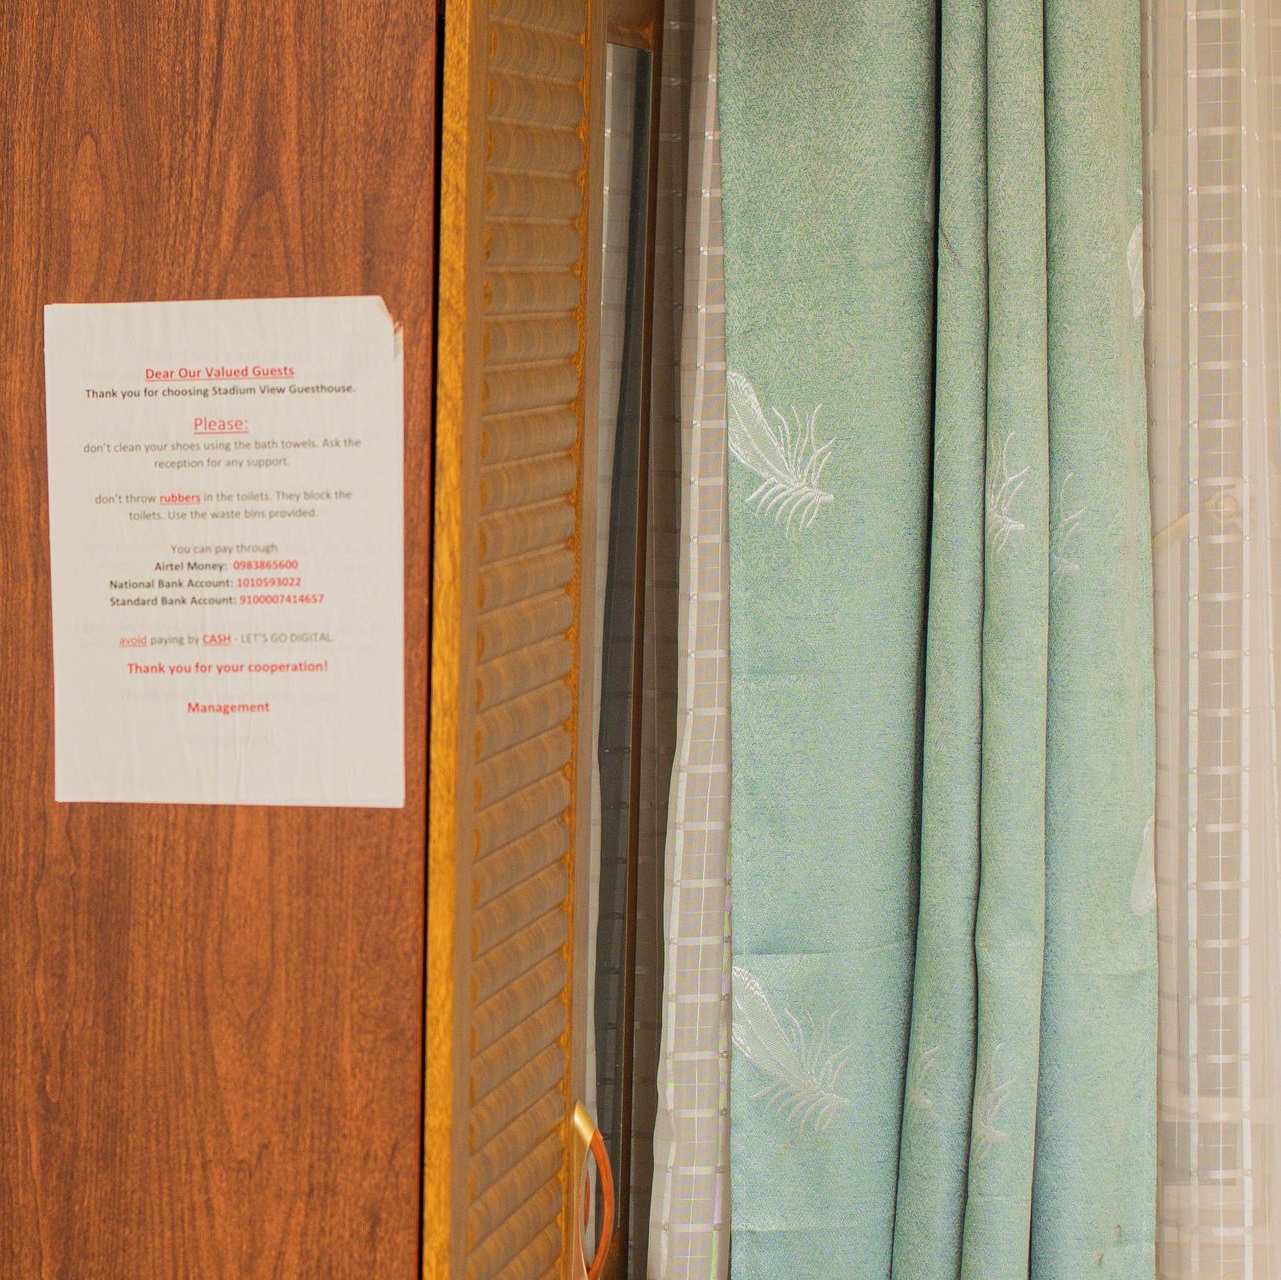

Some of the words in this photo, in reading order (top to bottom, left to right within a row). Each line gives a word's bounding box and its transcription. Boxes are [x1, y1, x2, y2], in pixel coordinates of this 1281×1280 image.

[145, 368, 174, 380] Dear
[178, 368, 201, 378] Our
[206, 367, 248, 378] Valued
[253, 366, 294, 377] Guests
[86, 389, 118, 399] Thank
[121, 390, 140, 400] you
[143, 388, 158, 397] for
[162, 387, 208, 398] choosing
[212, 386, 255, 396] Stadium
[260, 385, 285, 394] View
[289, 384, 356, 394] Guesthouse.
[193, 417, 249, 431] Please:
[114, 442, 141, 452] clean
[144, 443, 167, 453] your
[170, 441, 200, 451] shoes
[203, 441, 230, 452] using
[234, 440, 251, 449] the
[255, 440, 278, 449] bath
[281, 439, 318, 448] towels.
[322, 438, 340, 448] Ask
[344, 438, 361, 447] the
[154, 458, 203, 470] reception
[207, 458, 222, 468] for
[225, 459, 243, 469] any
[247, 457, 289, 468] support.
[125, 494, 156, 503] throw
[160, 494, 200, 503] rubbers
[204, 493, 213, 502] in
[216, 492, 233, 502] the
[237, 491, 272, 502] toilets.
[276, 491, 300, 501] They
[304, 490, 332, 500] block
[335, 490, 351, 500] the
[129, 511, 164, 521] toilets.
[168, 511, 187, 520] Use
[190, 510, 207, 520] the
[210, 511, 241, 519] waste
[245, 509, 265, 518] bins
[269, 508, 318, 519] provided.
[171, 545, 190, 554] You
[193, 546, 212, 554] can
[215, 546, 233, 555] pay
[236, 543, 278, 554] through
[154, 562, 184, 571] Airtel
[187, 562, 228, 573] Money:
[233, 561, 298, 570] 0983865600
[110, 579, 154, 589] National
[158, 579, 183, 588] Bank
[187, 578, 233, 588] Account:
[237, 577, 301, 587] 1010593022
[110, 596, 157, 606] Standard
[161, 596, 187, 606] Bank
[191, 596, 237, 605] Account:
[240, 594, 324, 604] 9100007414657
[119, 636, 147, 646] avoid
[150, 635, 185, 646] paying
[187, 634, 200, 645] by
[203, 634, 230, 644] CASH
[271, 633, 287, 643] GO
[290, 632, 335, 643] DIGITAL.
[127, 663, 164, 673] Thank
[169, 664, 191, 675] you
[195, 662, 212, 672] for
[216, 663, 244, 674] your
[248, 661, 328, 673] cooperation!
[187, 702, 269, 714] Management
